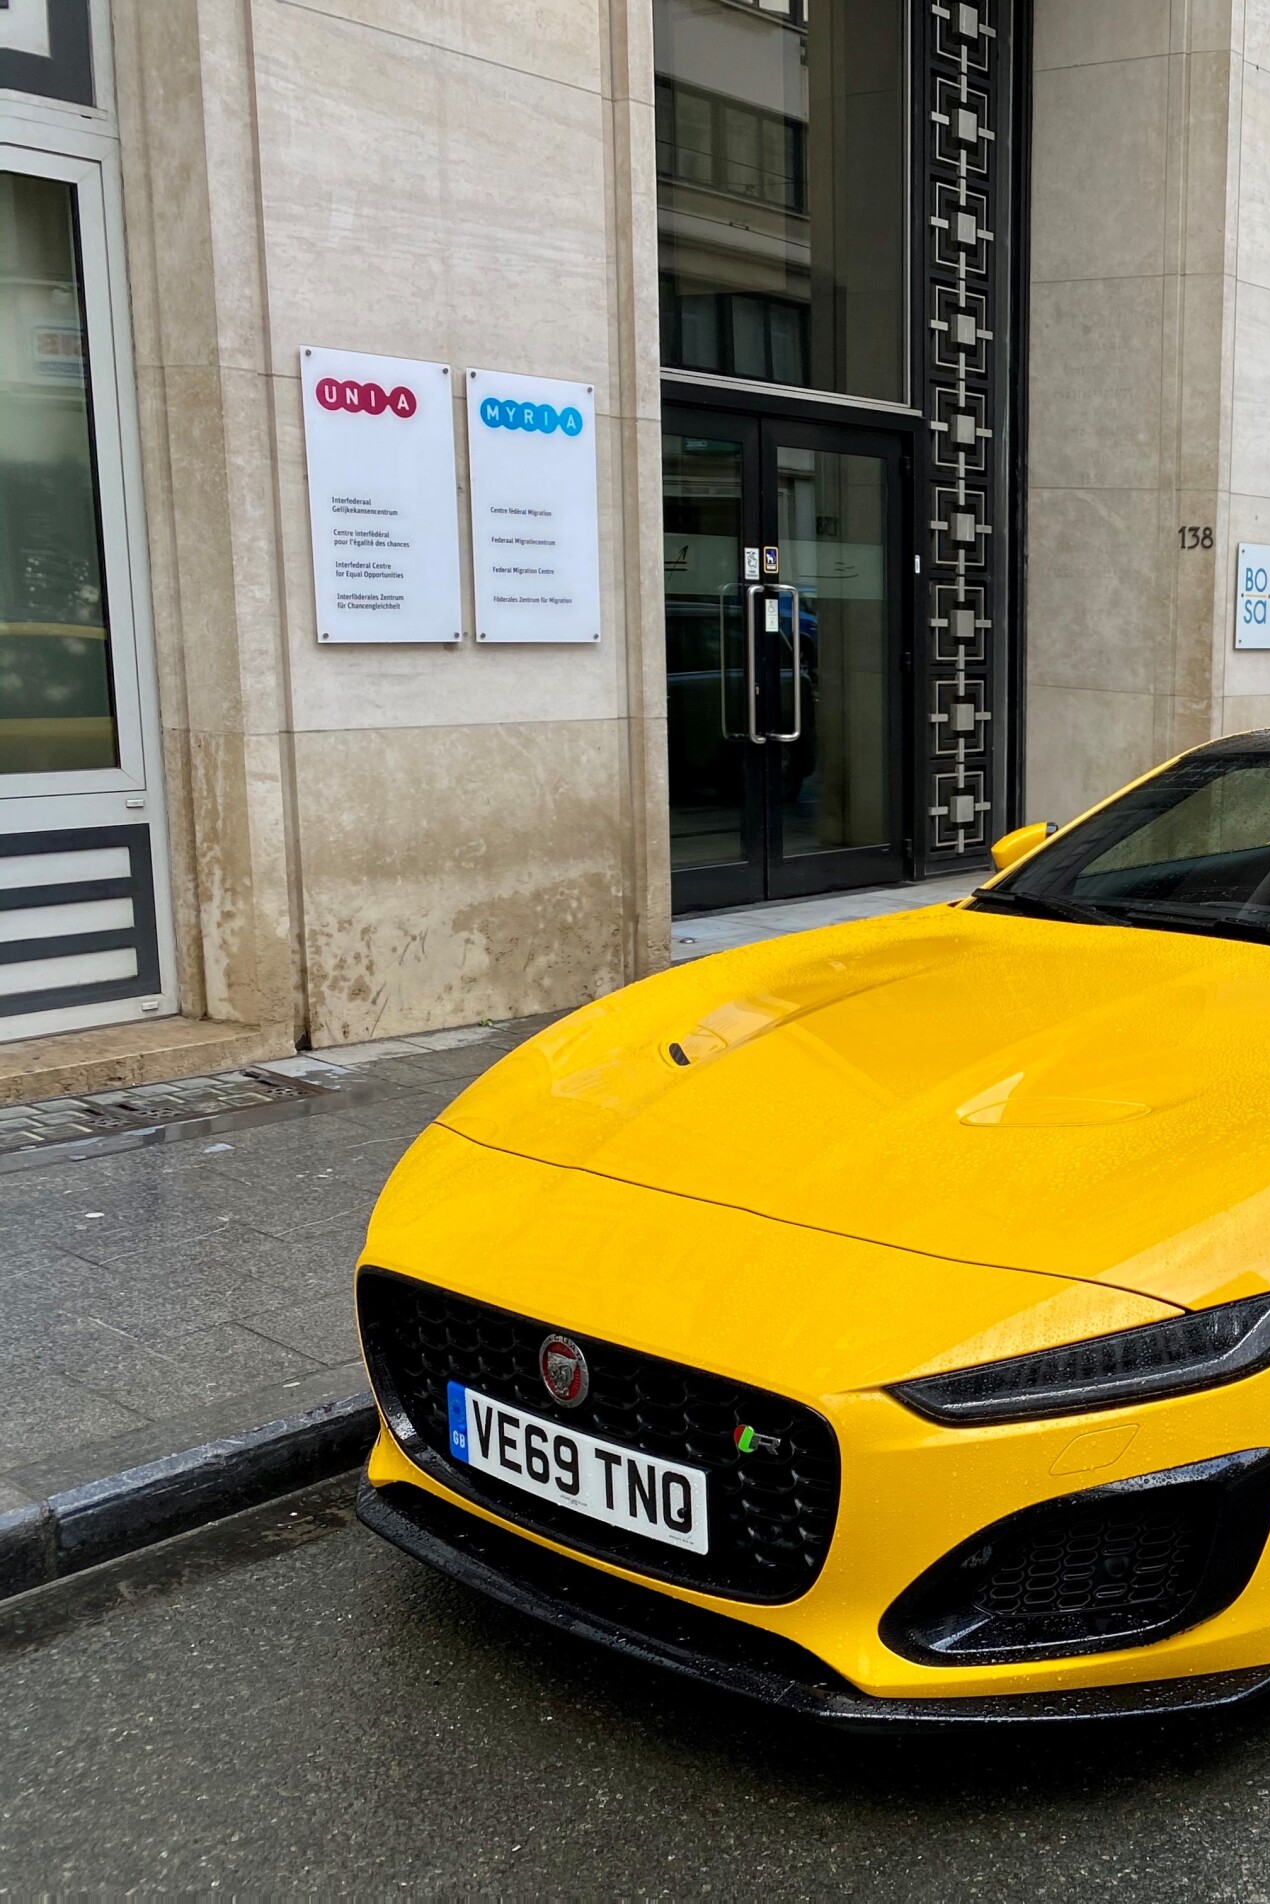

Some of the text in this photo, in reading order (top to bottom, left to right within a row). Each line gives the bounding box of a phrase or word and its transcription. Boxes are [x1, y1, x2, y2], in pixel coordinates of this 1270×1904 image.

[323, 385, 410, 411] UNIA
[487, 404, 577, 429] MYRIA
[331, 496, 372, 505] Interfederaal
[332, 506, 398, 516] Gelijkekansencentrum
[528, 509, 552, 517] Migration
[492, 536, 514, 544] Federaal
[1178, 526, 1214, 549] 138
[387, 540, 410, 548] chances
[336, 561, 391, 570] Interfederal Centre
[346, 570, 362, 578] Equal
[364, 571, 404, 579] Opportunities
[513, 567, 537, 575] Migration
[1245, 567, 1268, 592] BO
[549, 597, 572, 605] Migration
[347, 602, 401, 611] Chancengleichheit
[453, 1430, 466, 1448] GB
[472, 1399, 580, 1496] VE69
